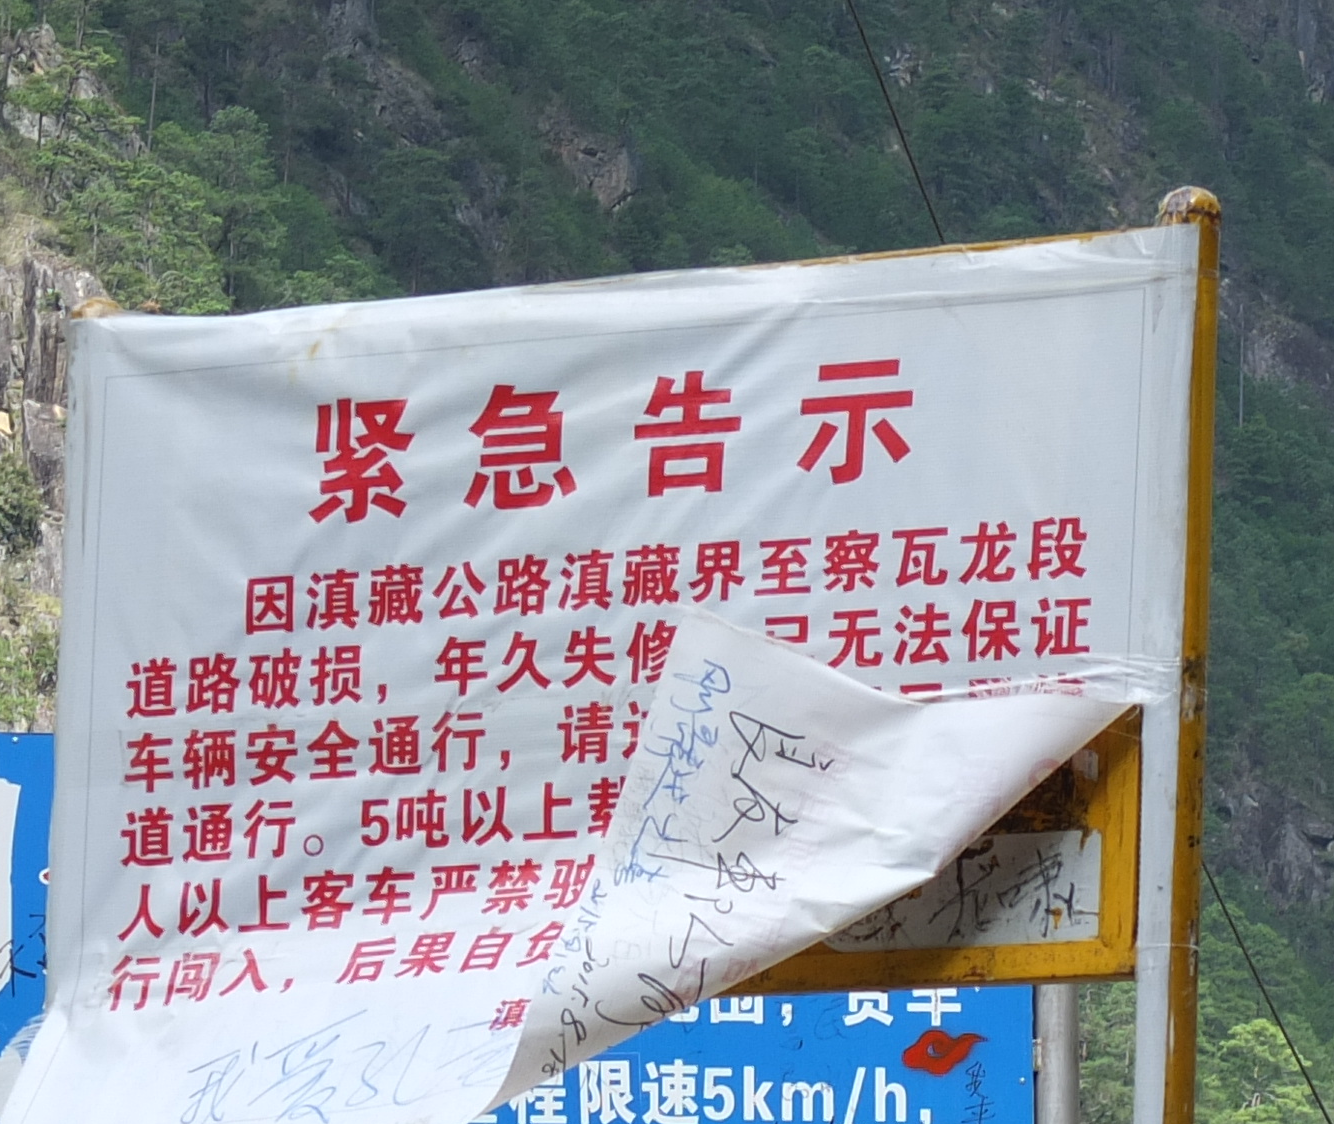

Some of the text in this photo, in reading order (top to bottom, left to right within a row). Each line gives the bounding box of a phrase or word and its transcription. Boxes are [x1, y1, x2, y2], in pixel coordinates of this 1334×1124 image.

[309, 358, 914, 523] 紧急告示
[245, 518, 1088, 635] 因滇藏公路滇藏界至察瓦龙段
